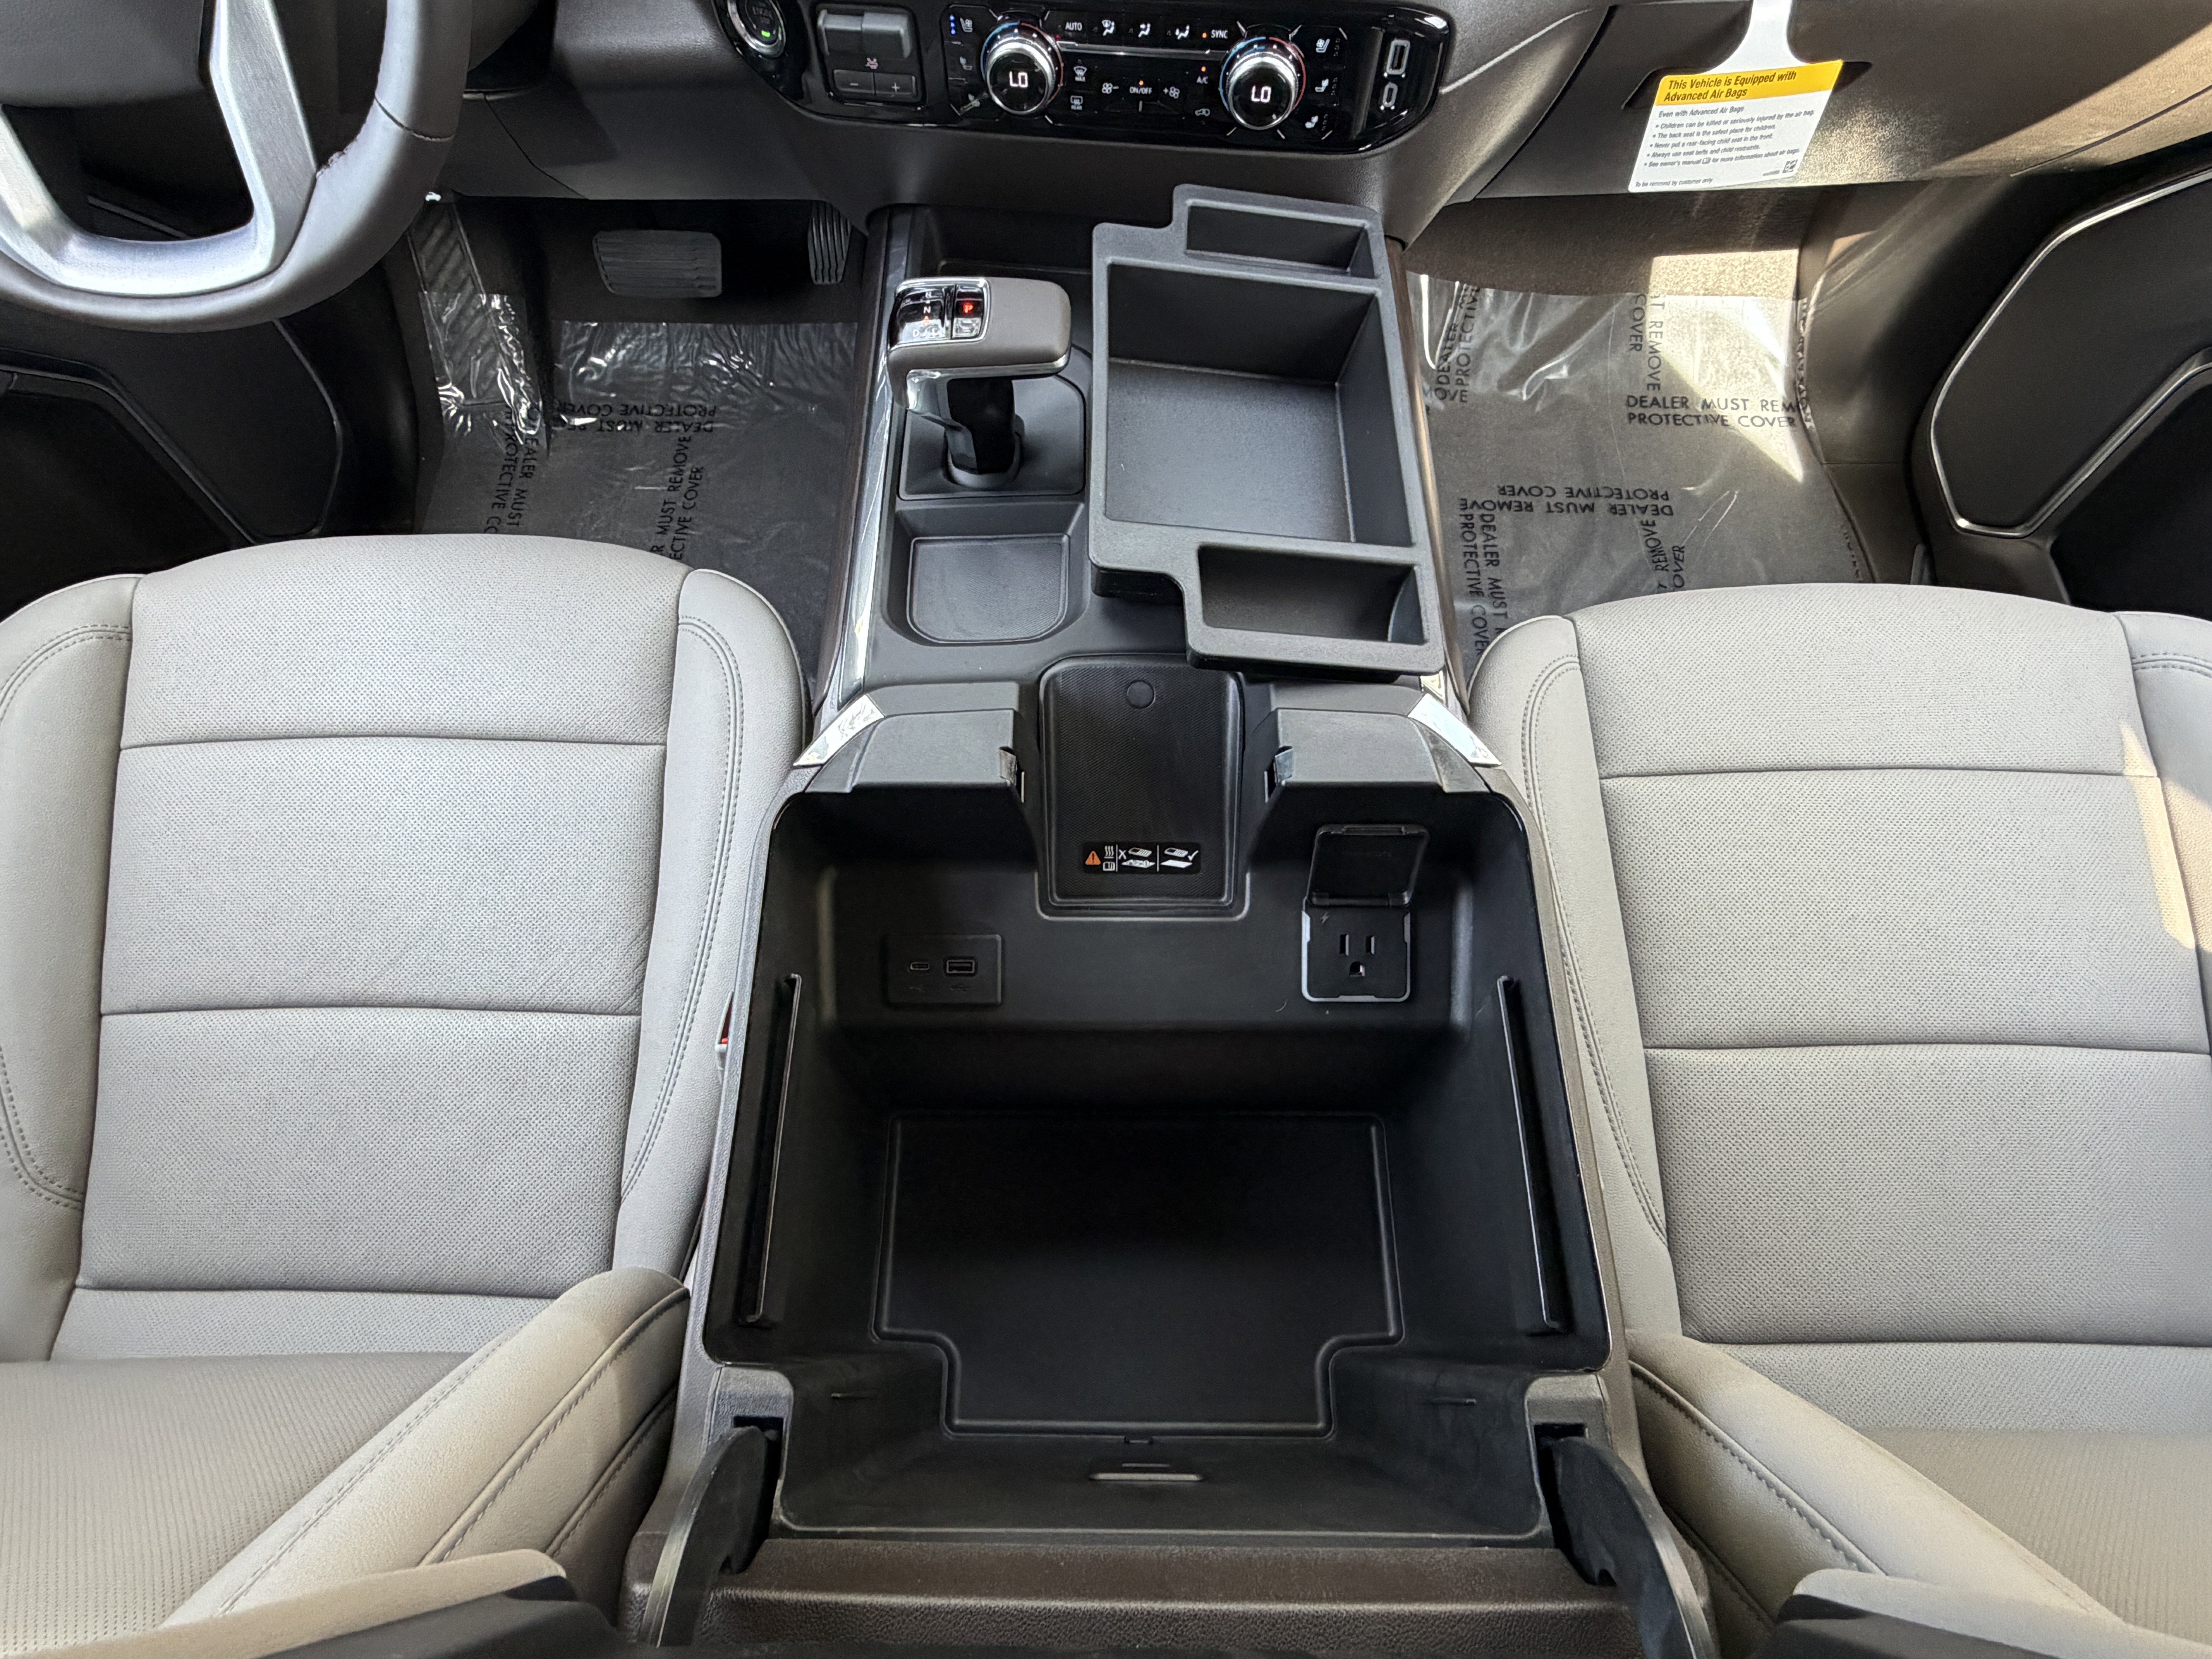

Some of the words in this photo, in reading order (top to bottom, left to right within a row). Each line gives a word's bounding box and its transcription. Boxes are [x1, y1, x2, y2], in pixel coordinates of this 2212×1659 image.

[1066, 22, 1082, 31] AUTO
[1211, 30, 1228, 39] SYNC
[1668, 79, 1687, 90] This
[1690, 77, 1722, 89] Vehicle
[1724, 76, 1732, 86] is
[1734, 72, 1776, 86] Equipped
[1777, 70, 1797, 81] with
[1664, 90, 1709, 102] Advanced
[1709, 89, 1724, 99] Air
[1725, 88, 1748, 99] Bags
[1689, 107, 1719, 116] Advanced
[1756, 114, 1776, 123] injured
[1734, 153, 1763, 161] information
[923, 306, 931, 314] N
[964, 302, 974, 313] P
[1629, 294, 1646, 352] COVER
[1647, 321, 1664, 391] REMOVE
[620, 403, 716, 417] PROTECTIVE
[1626, 395, 1689, 409] DEALER
[1701, 398, 1750, 411] MUST
[654, 420, 714, 433] DEALER
[1628, 412, 1730, 426] PROTECTIVE
[1737, 415, 1795, 428] COVER
[656, 498, 677, 535] MUST
[667, 435, 692, 492] REMOVE
[1498, 484, 1556, 497] COVER
[1565, 486, 1669, 501] PROTECTIVE
[507, 488, 527, 527] MUST
[669, 516, 692, 560] ECTIVE
[682, 466, 704, 510] COVER
[1459, 498, 1534, 513] REMOVE
[1546, 502, 1595, 514] MUST
[1607, 503, 1674, 516] DEALER
[1479, 513, 1500, 568] DEALER
[1639, 520, 1669, 572] REMOVE
[1459, 513, 1485, 598] PROTECTIVE
[1671, 545, 1685, 589] OVER
[1487, 577, 1509, 619] MUST
